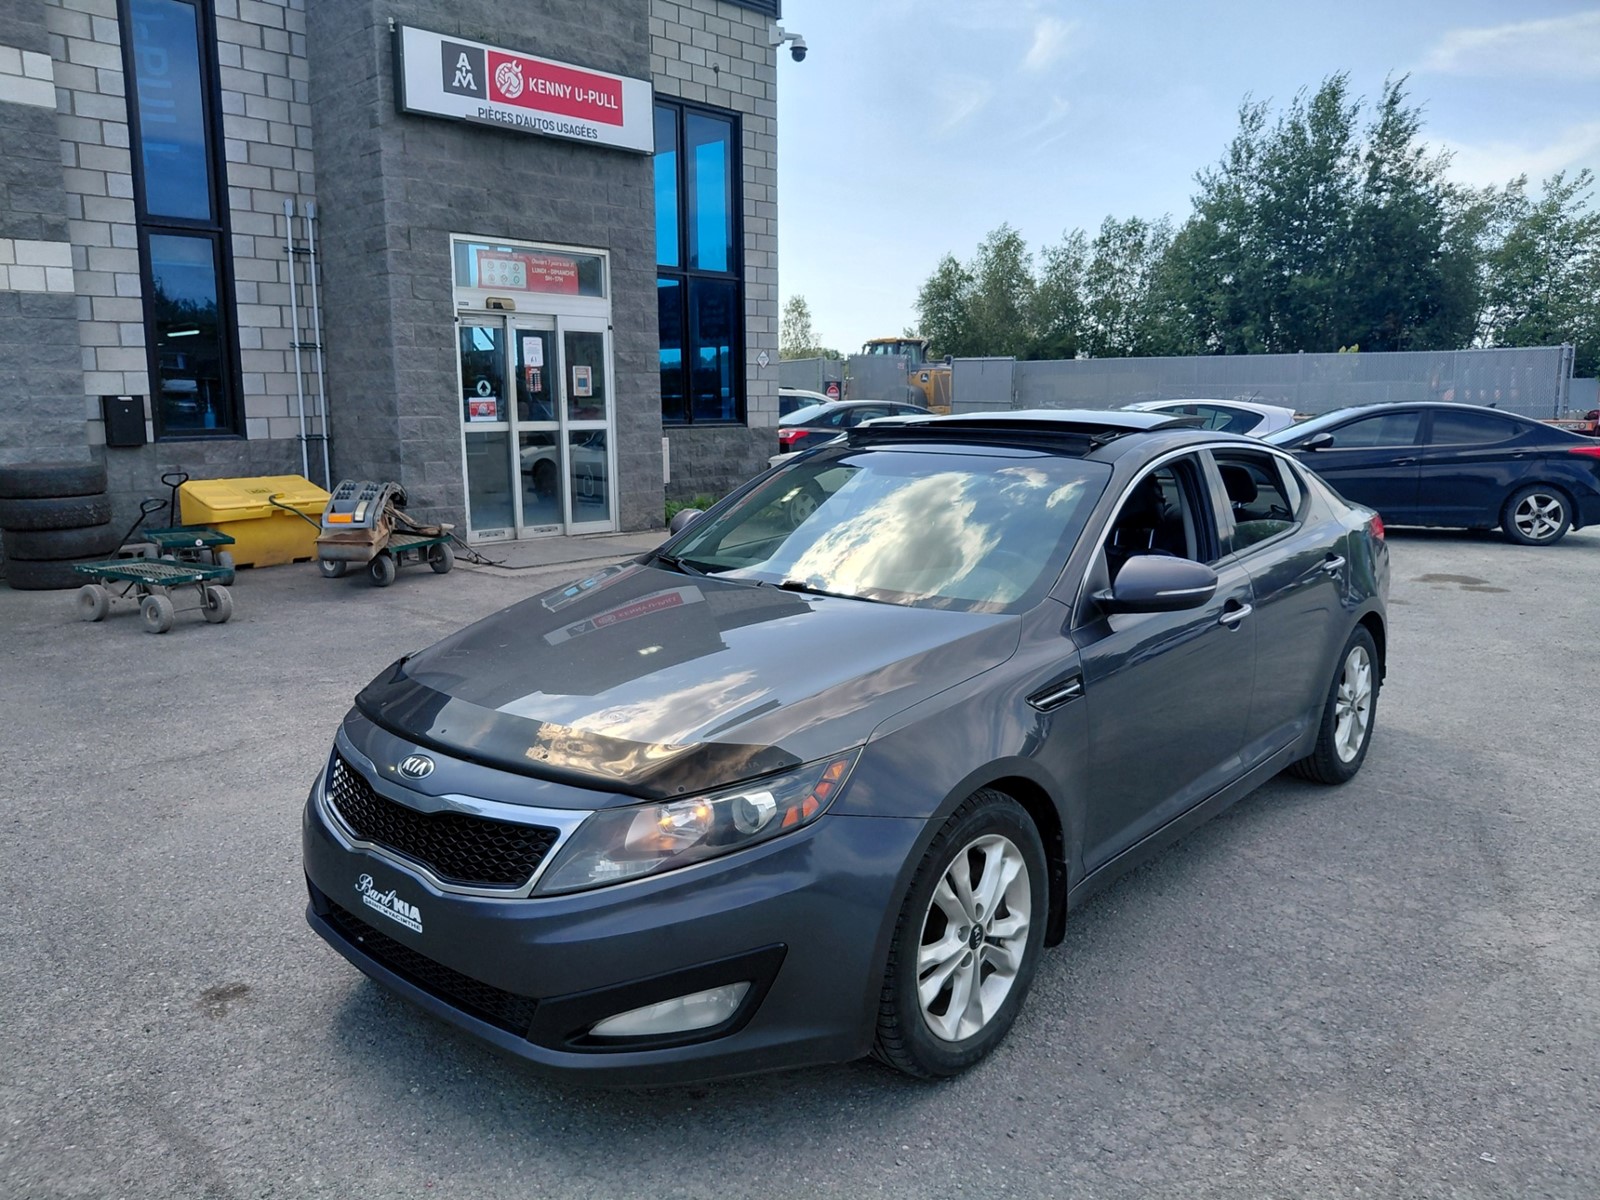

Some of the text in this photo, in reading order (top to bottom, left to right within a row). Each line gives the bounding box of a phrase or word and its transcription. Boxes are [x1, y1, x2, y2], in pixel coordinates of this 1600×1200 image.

[529, 77, 619, 110] KENNY U-PULL
[477, 106, 515, 124] PIÈCES
[556, 122, 599, 140] USAGÉES
[402, 756, 429, 776] KIA
[354, 873, 422, 923] Baril KIA
[973, 926, 981, 947] KIA
